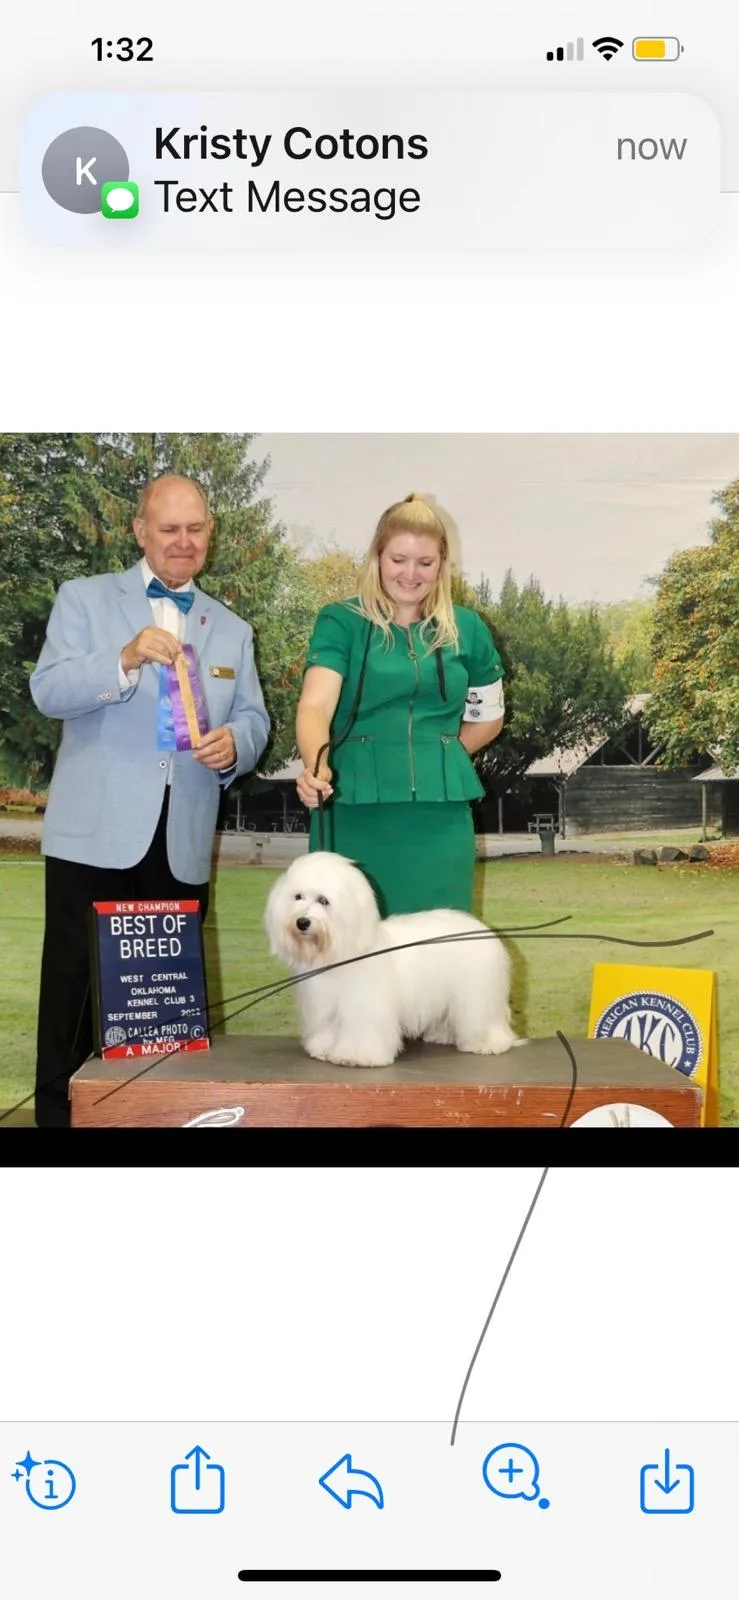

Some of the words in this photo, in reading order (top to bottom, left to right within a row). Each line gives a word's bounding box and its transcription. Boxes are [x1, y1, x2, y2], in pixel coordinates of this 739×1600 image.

[92, 37, 153, 61] 1:32
[156, 125, 271, 167] Kristy
[284, 127, 428, 159] Cotons
[618, 138, 687, 160] now
[77, 157, 97, 185] K
[154, 181, 233, 212] Text
[249, 181, 420, 220] Message
[115, 903, 134, 912] NEW
[138, 902, 180, 911] CHAMPION
[110, 915, 157, 936] BEST
[162, 914, 186, 934] OF
[119, 937, 182, 959] BREED
[120, 974, 144, 983] WEST
[151, 972, 188, 982] CENTRAL
[127, 998, 159, 1008] KENNEL
[164, 996, 186, 1005] CLUB
[130, 986, 177, 996] OKLAHOMA
[107, 1011, 158, 1021] SEPTEMBER
[600, 998, 639, 1038] MERICAN
[641, 996, 685, 1023] KENNEL
[682, 1022, 696, 1055] CLUB
[128, 1025, 159, 1038] CALLEA
[161, 1023, 189, 1035] PHOTO
[126, 1047, 134, 1056] A
